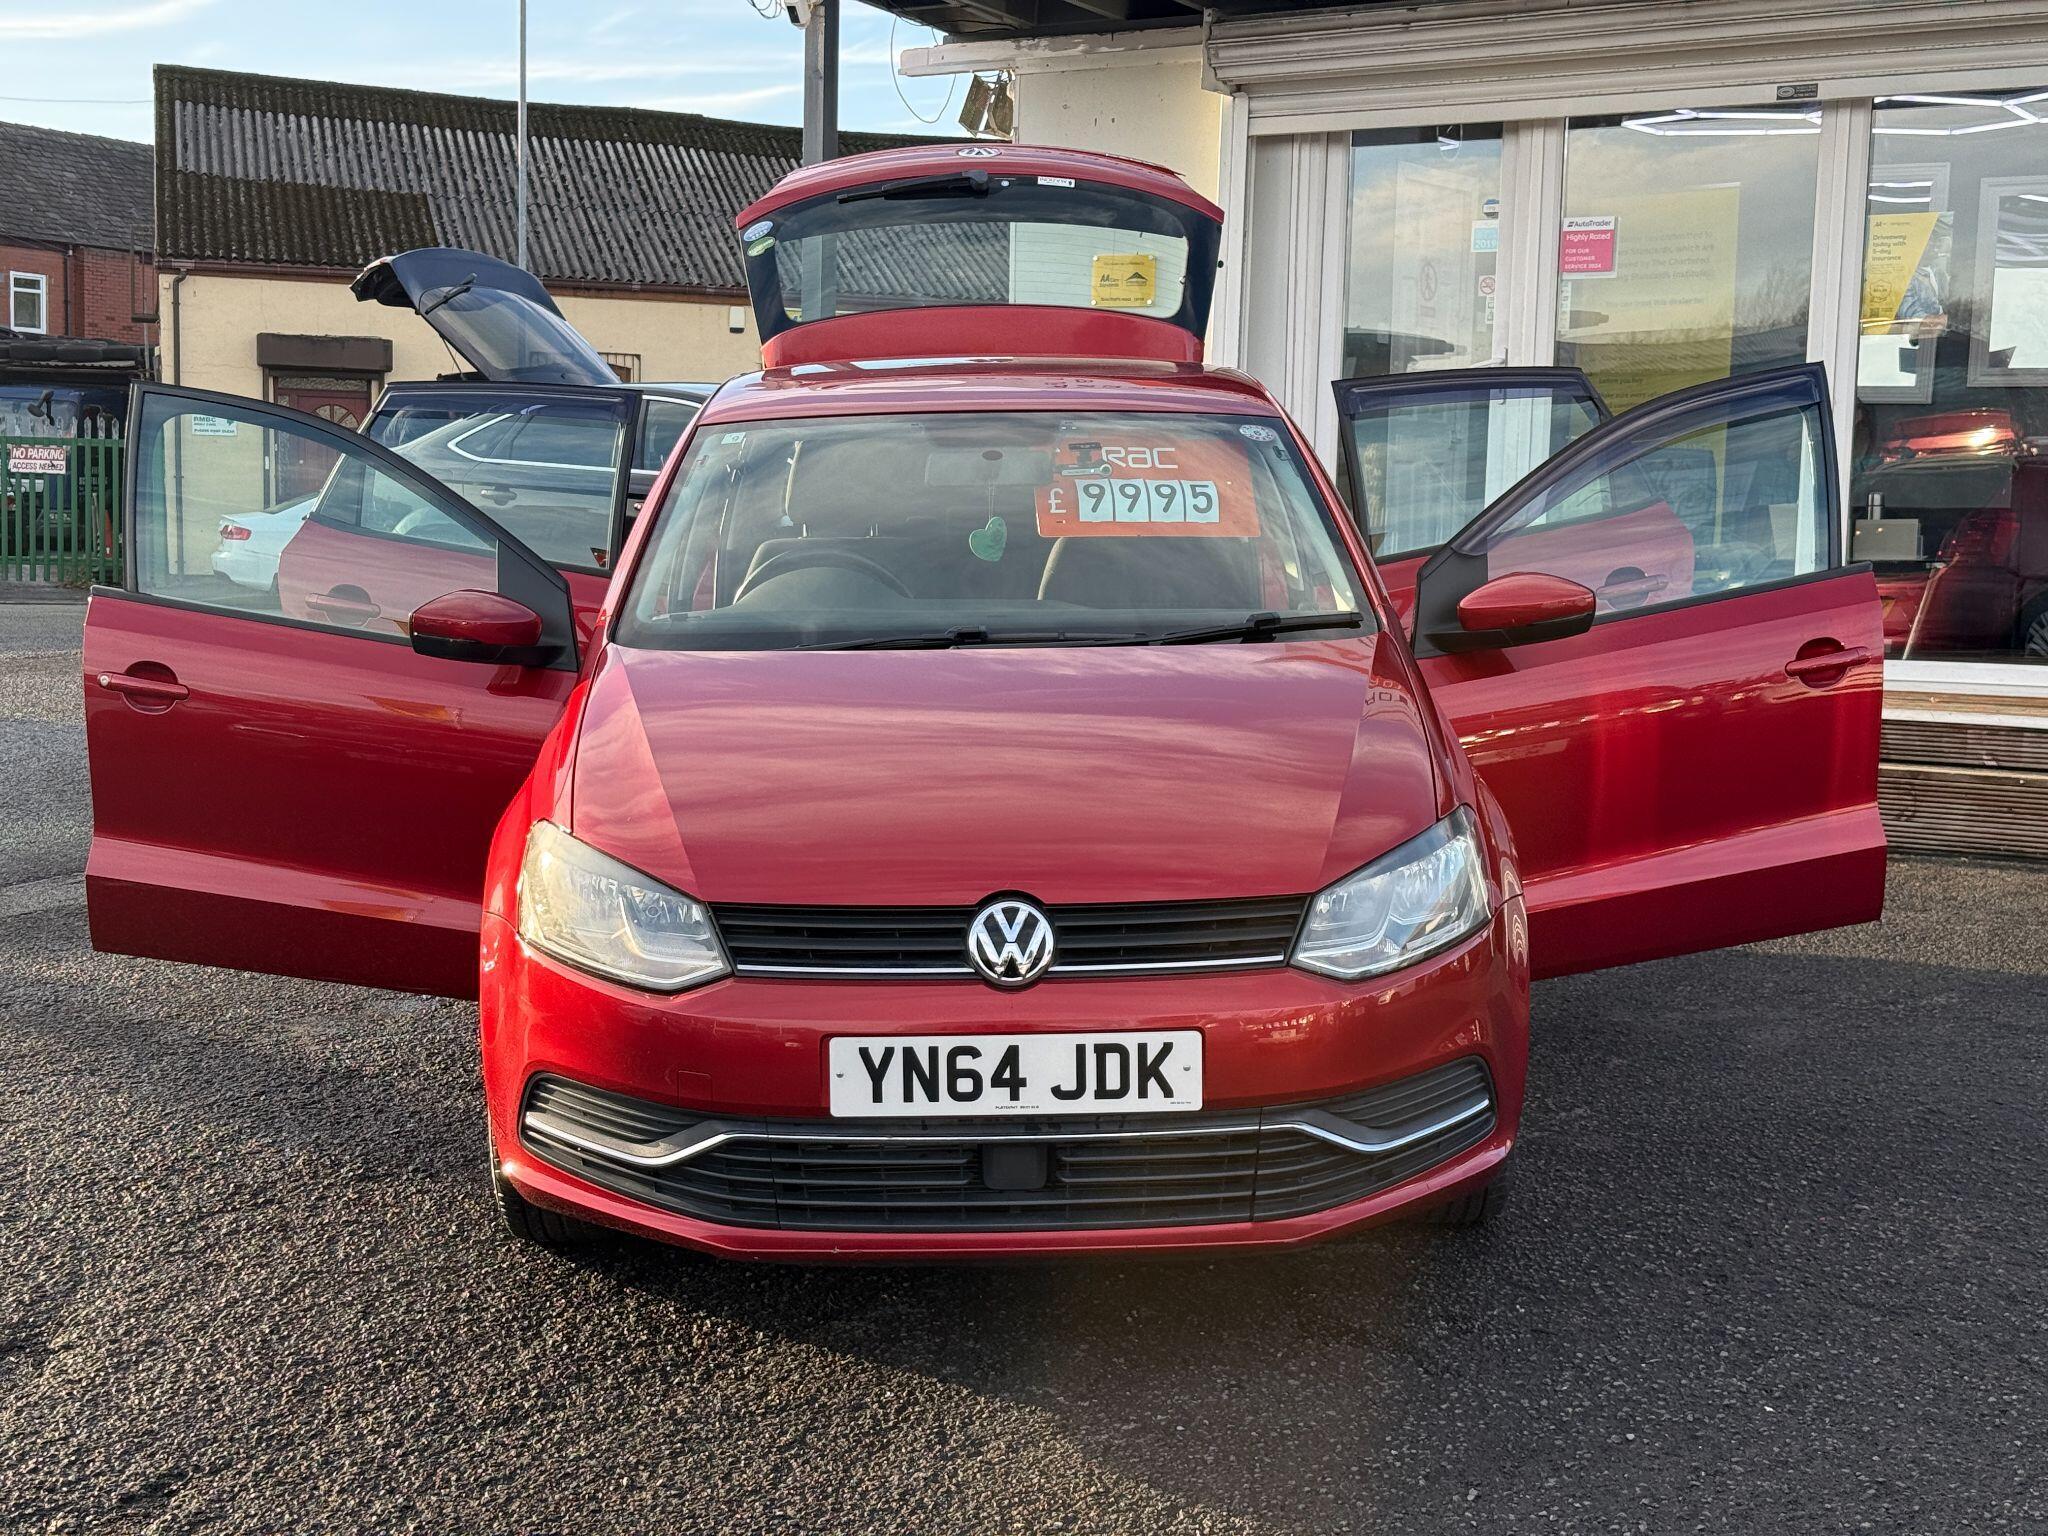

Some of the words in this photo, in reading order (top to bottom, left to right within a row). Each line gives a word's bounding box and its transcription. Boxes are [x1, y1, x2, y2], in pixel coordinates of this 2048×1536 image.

[1574, 219, 1612, 228] AutoTrader
[1566, 232, 1588, 242] Highly
[1589, 231, 1611, 241] Rated
[12, 447, 26, 459] NO
[27, 448, 64, 460] PARKING
[12, 462, 37, 471] ACCESS
[858, 1045, 1027, 1103] YN64
[1050, 1042, 1174, 1100] JDK
